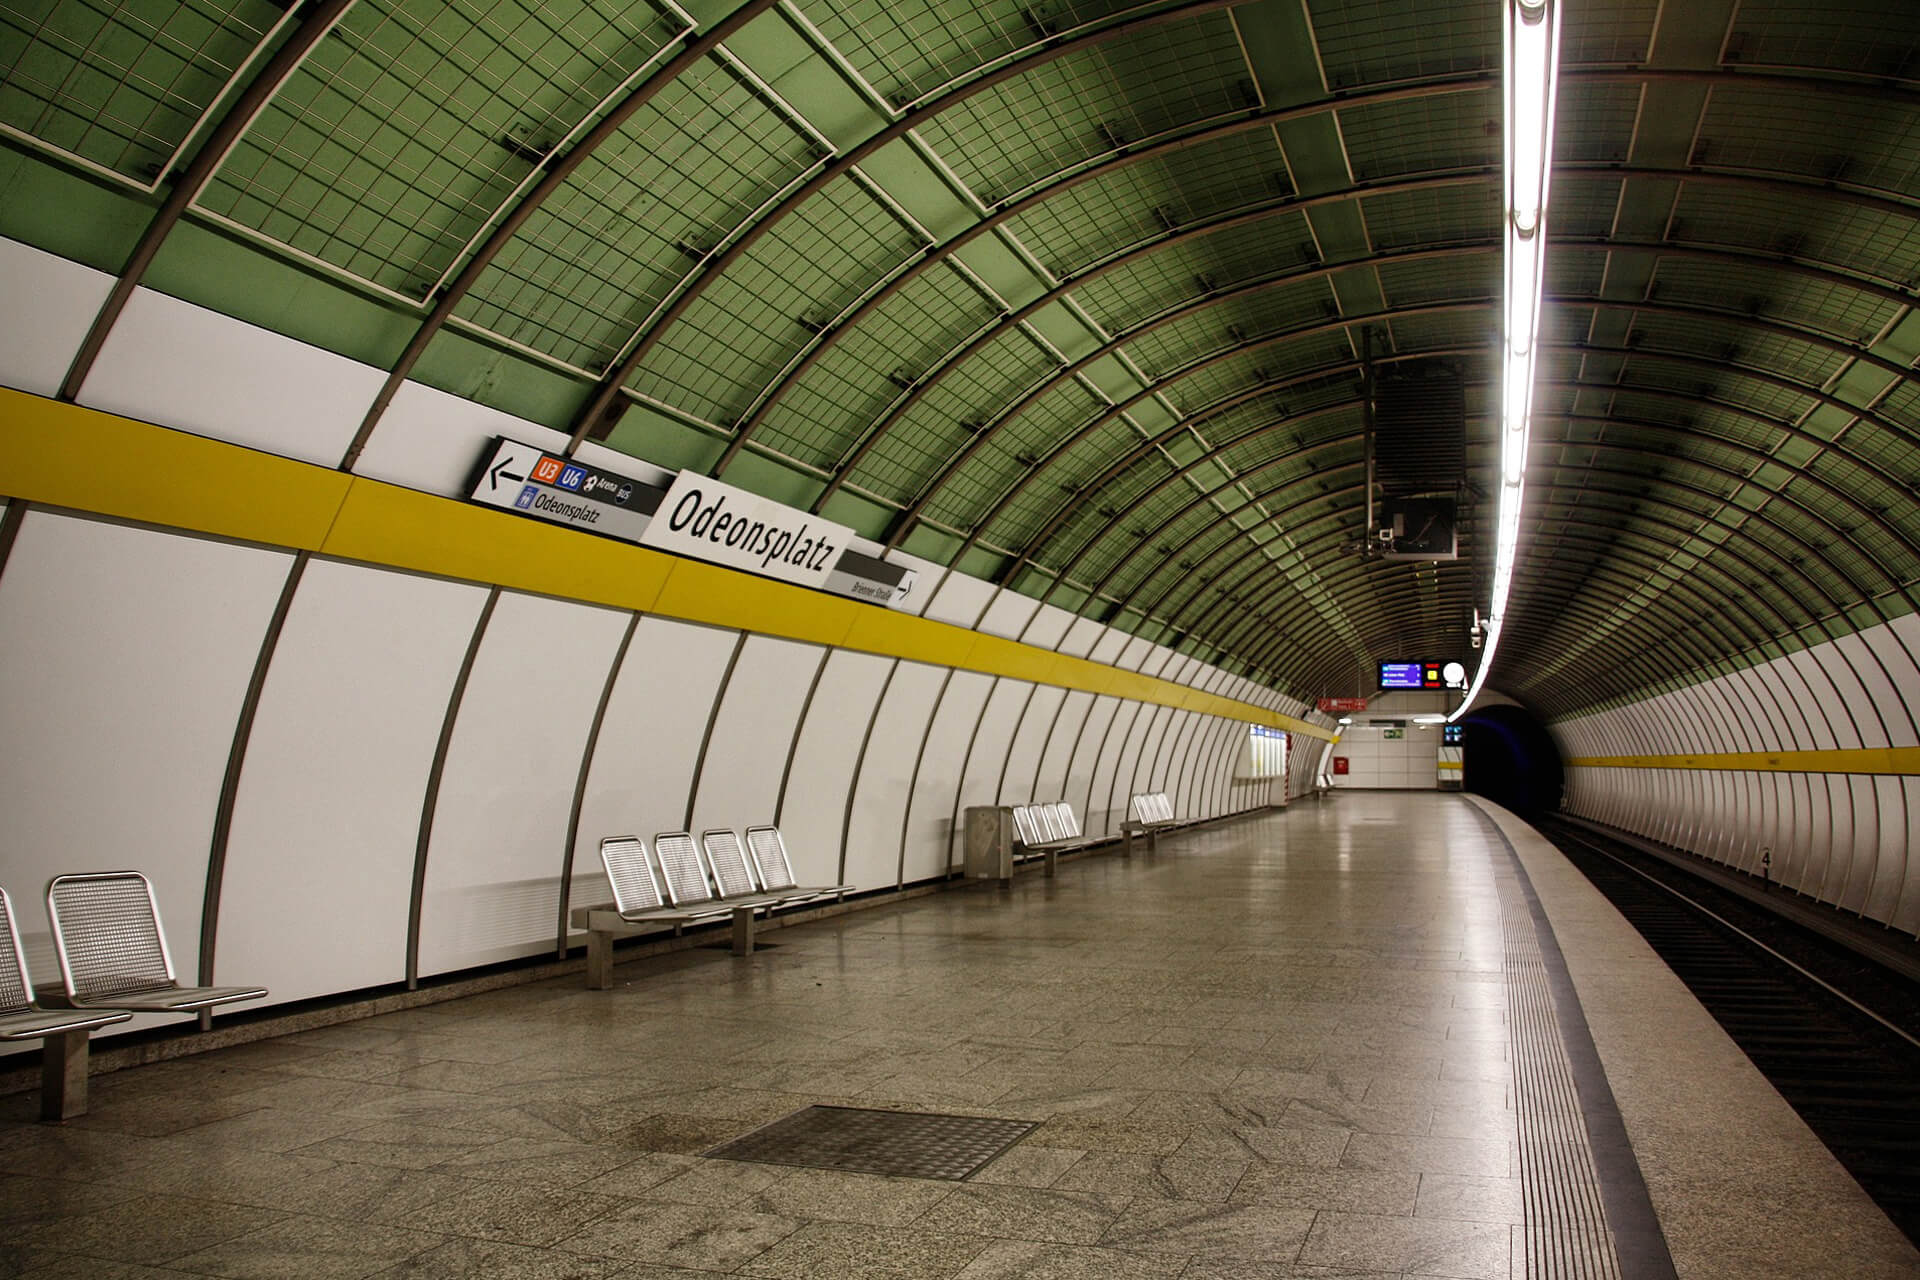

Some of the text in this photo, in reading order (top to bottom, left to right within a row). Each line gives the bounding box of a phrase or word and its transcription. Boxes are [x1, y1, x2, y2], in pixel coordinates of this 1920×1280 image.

[538, 461, 559, 479] U3
[561, 469, 580, 487] U6
[596, 478, 618, 493] Arena
[534, 493, 600, 524] Odeonsplatz
[668, 489, 835, 572] Odeonsplatz
